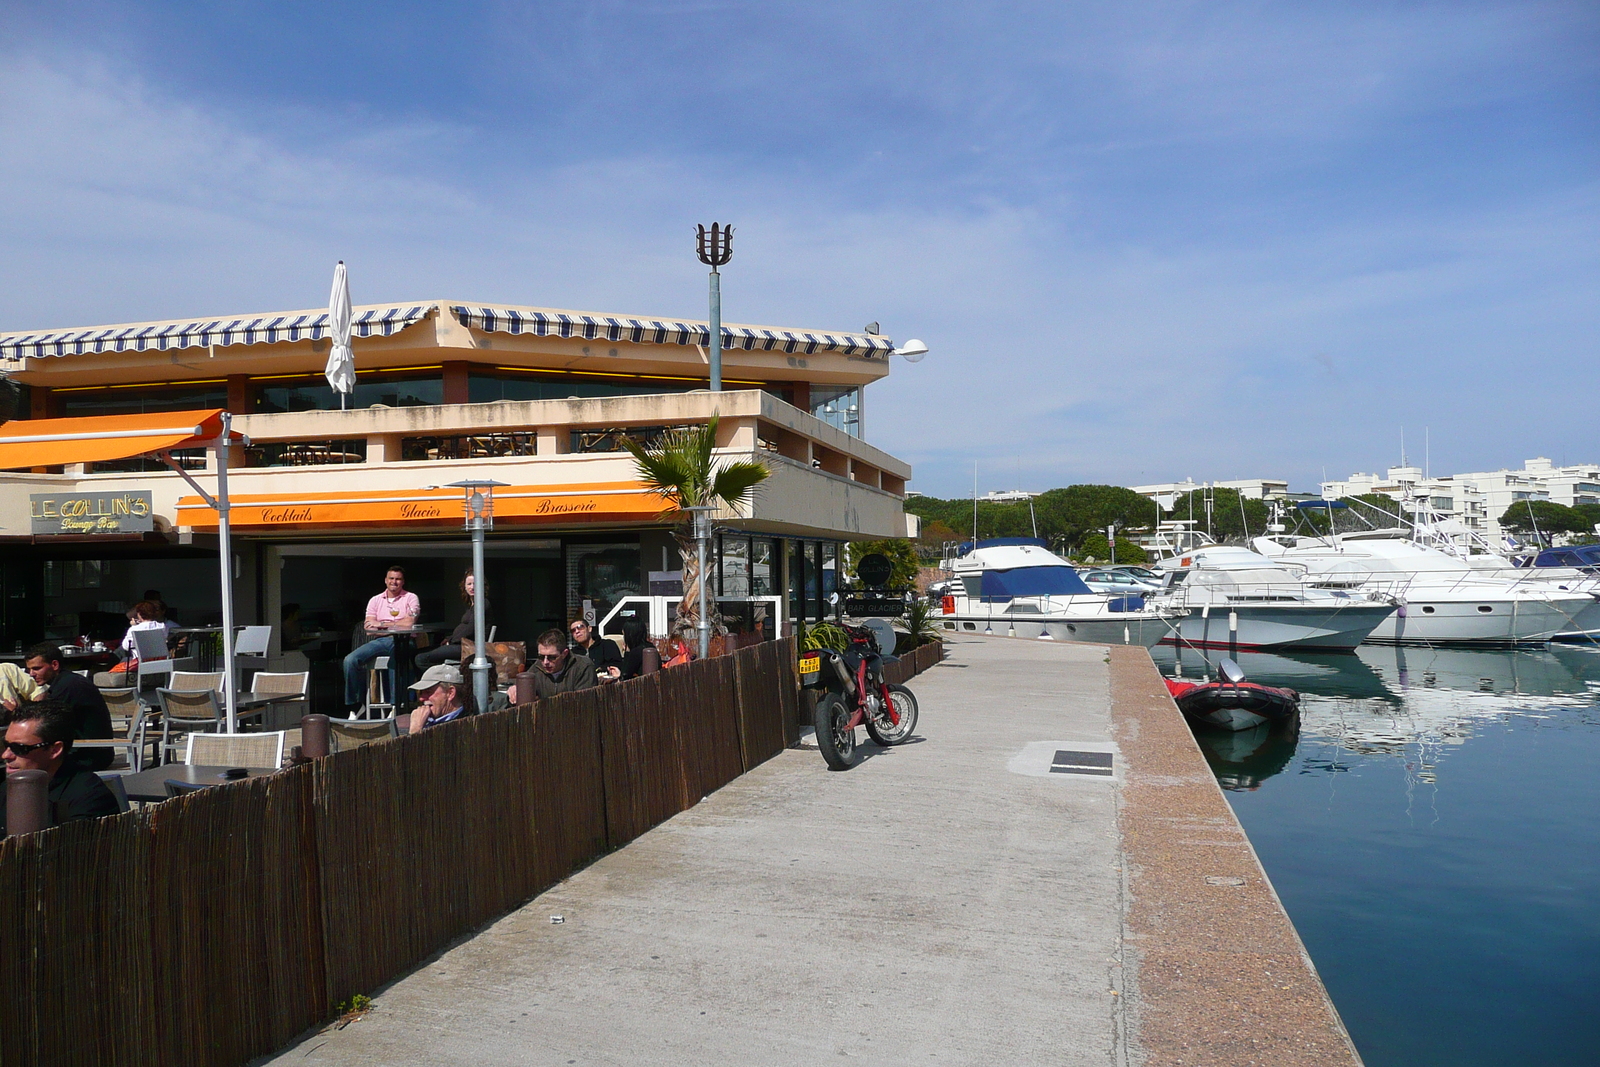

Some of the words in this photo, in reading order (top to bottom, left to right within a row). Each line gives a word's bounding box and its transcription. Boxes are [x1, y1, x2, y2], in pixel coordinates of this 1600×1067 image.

[30, 500, 60, 518] LE
[261, 508, 313, 523] Cocktails
[400, 504, 441, 519] Glacier
[535, 499, 597, 514] Brasserie
[61, 517, 96, 533] Lounge
[97, 516, 119, 529] Bar
[848, 604, 865, 612] BAR
[867, 604, 903, 612] GLACIER
